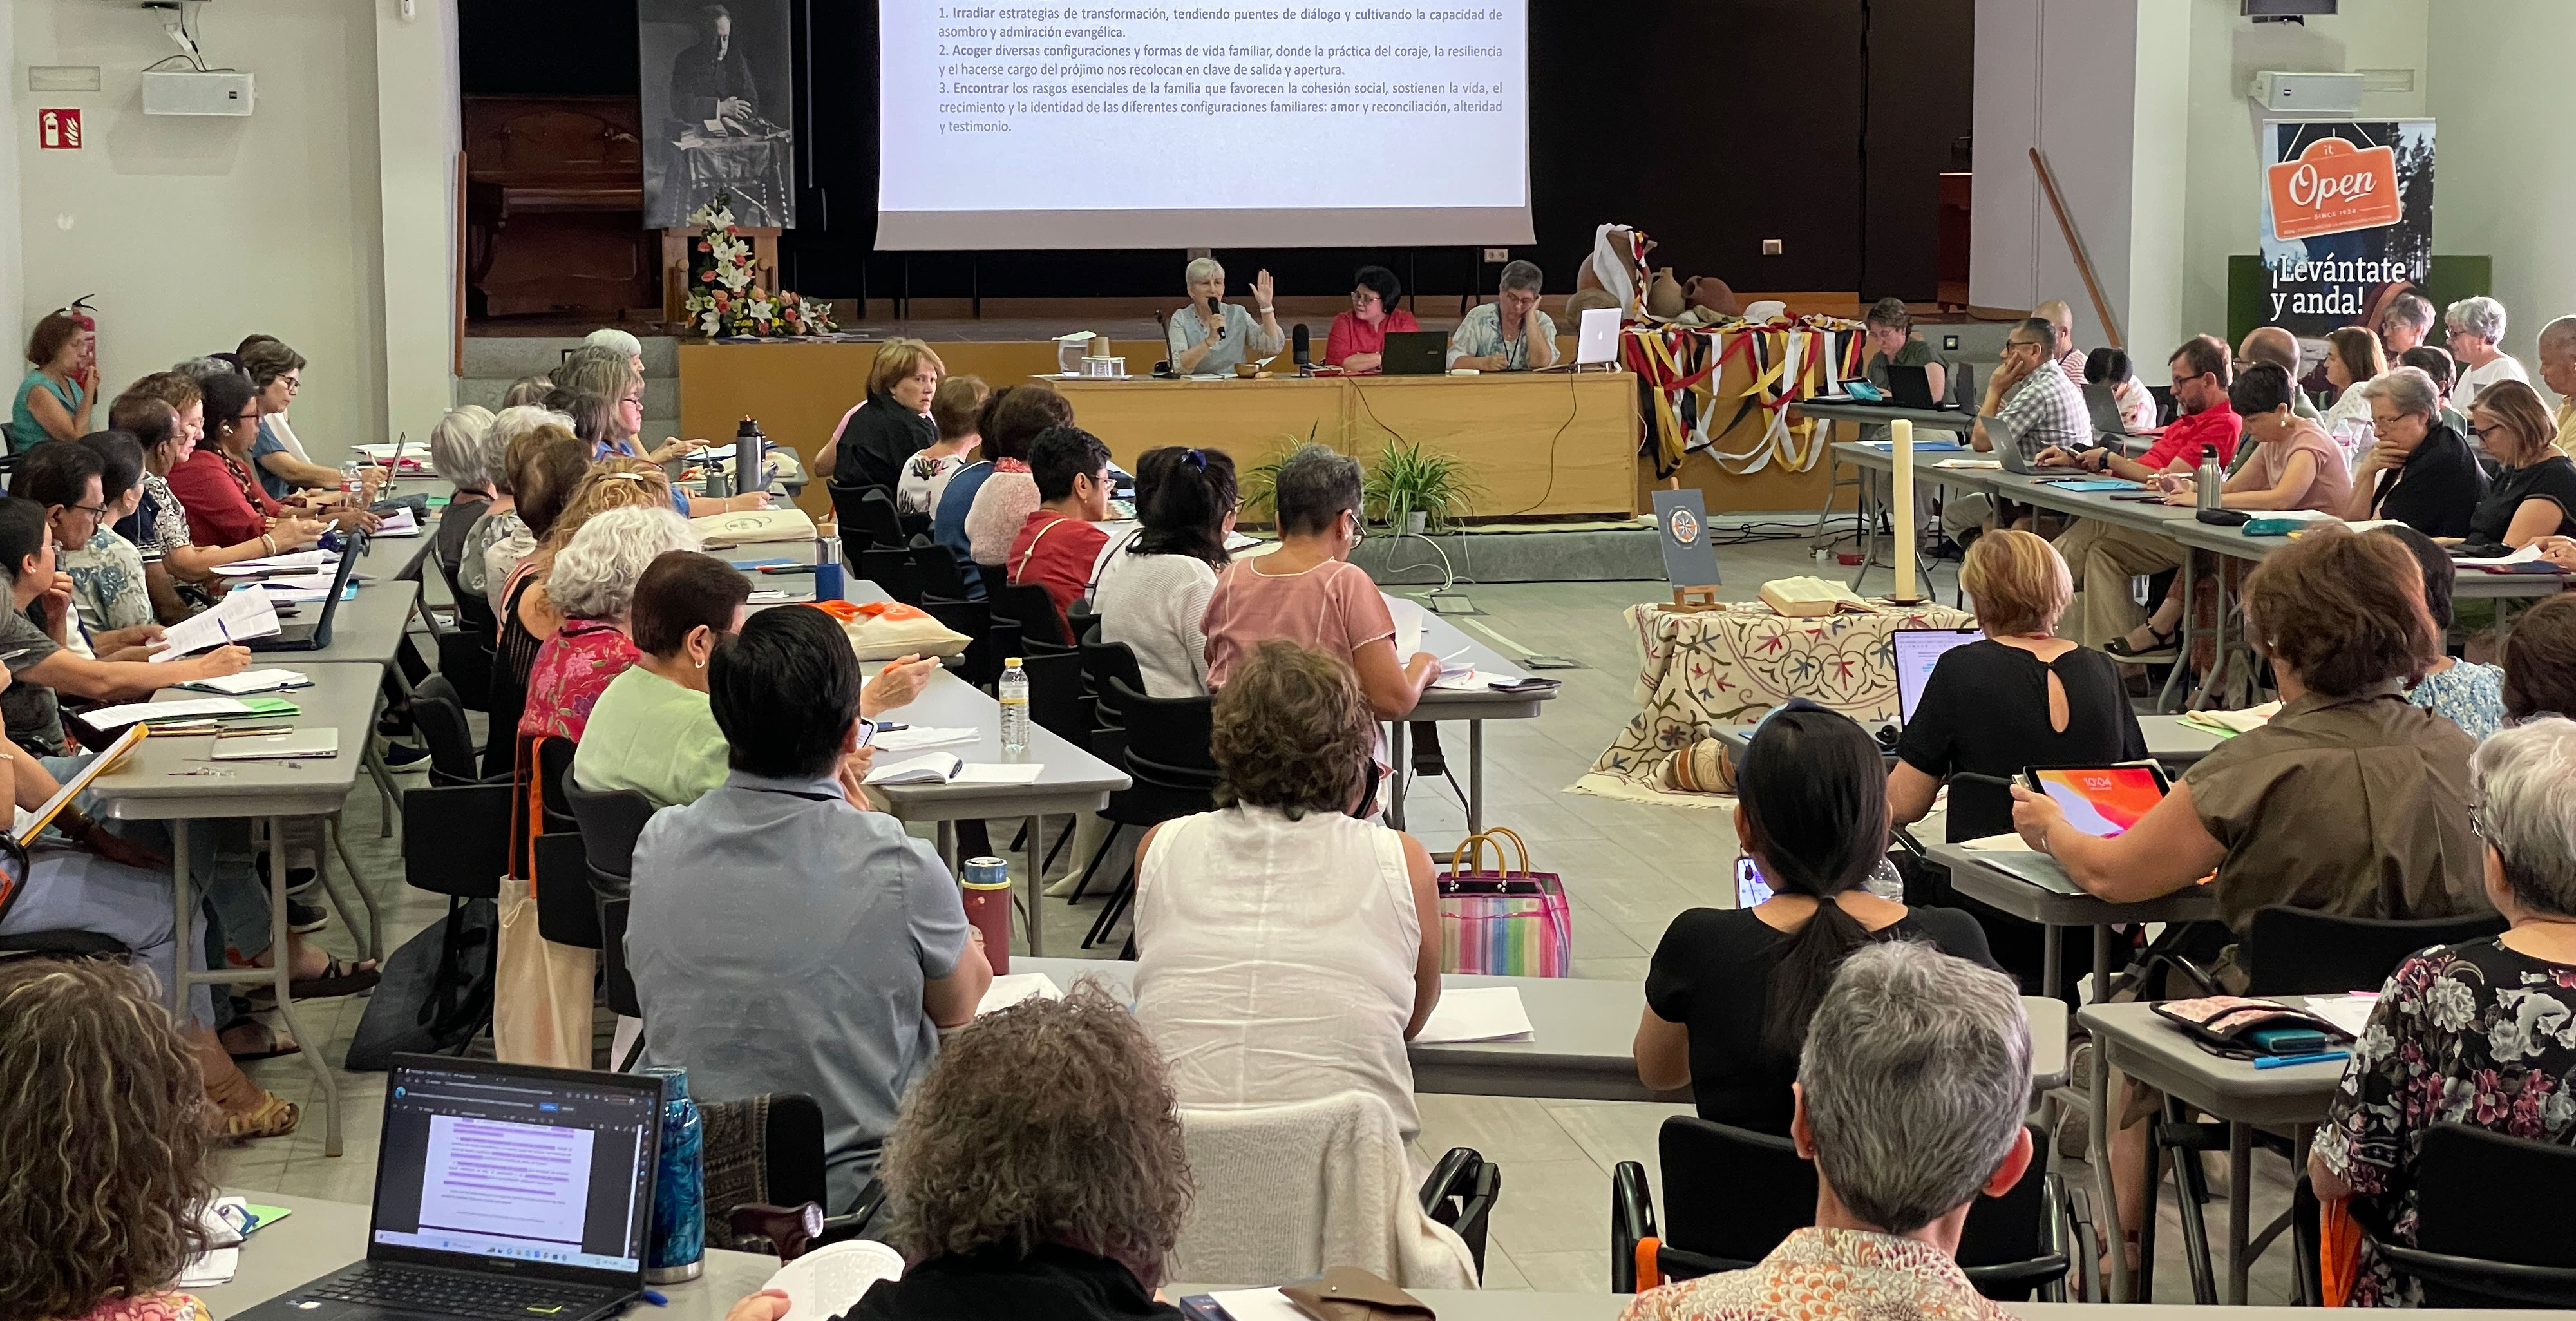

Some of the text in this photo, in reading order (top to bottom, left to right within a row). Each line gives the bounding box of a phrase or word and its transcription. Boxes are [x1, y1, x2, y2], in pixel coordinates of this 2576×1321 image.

[938, 6, 1503, 23] 1. Irradiar estrategias de transformación, tendiendo puentes de diálogo y cultivando la capacidad de
[938, 24, 1126, 41] asombro y admiración evangélica.
[938, 44, 1502, 60] 2. Acoger diversas configuraciones y formas de vida familiar, donde la práctica del coraje, la resiliencia
[938, 62, 1345, 78] y el hacerse cargo del prójimo nos recolocan en clave de salida y apertura.
[938, 81, 1502, 97] 3. Encontrar los rasgos esenciales de la familia que favorecen la cohesión social, sostienen la vida, el
[939, 100, 1005, 113] crecimiento
[1008, 104, 1015, 115] y
[1018, 100, 1027, 113] la
[1086, 100, 1101, 113] de
[1104, 100, 1119, 113] las
[1180, 100, 1267, 115] configuraciones
[1270, 100, 1327, 113] familiares:
[1330, 103, 1360, 113] amor
[1362, 103, 1369, 115] y
[1372, 100, 1450, 114] reconciliación,
[1454, 100, 1502, 113] alteridad
[939, 120, 1012, 135] y testimonio.
[2324, 145, 2334, 155] it
[2289, 164, 2377, 210] Open
[2313, 211, 2336, 220] SINCE
[2272, 252, 2407, 289] ¡Levántate
[2270, 285, 2364, 322] y anda!
